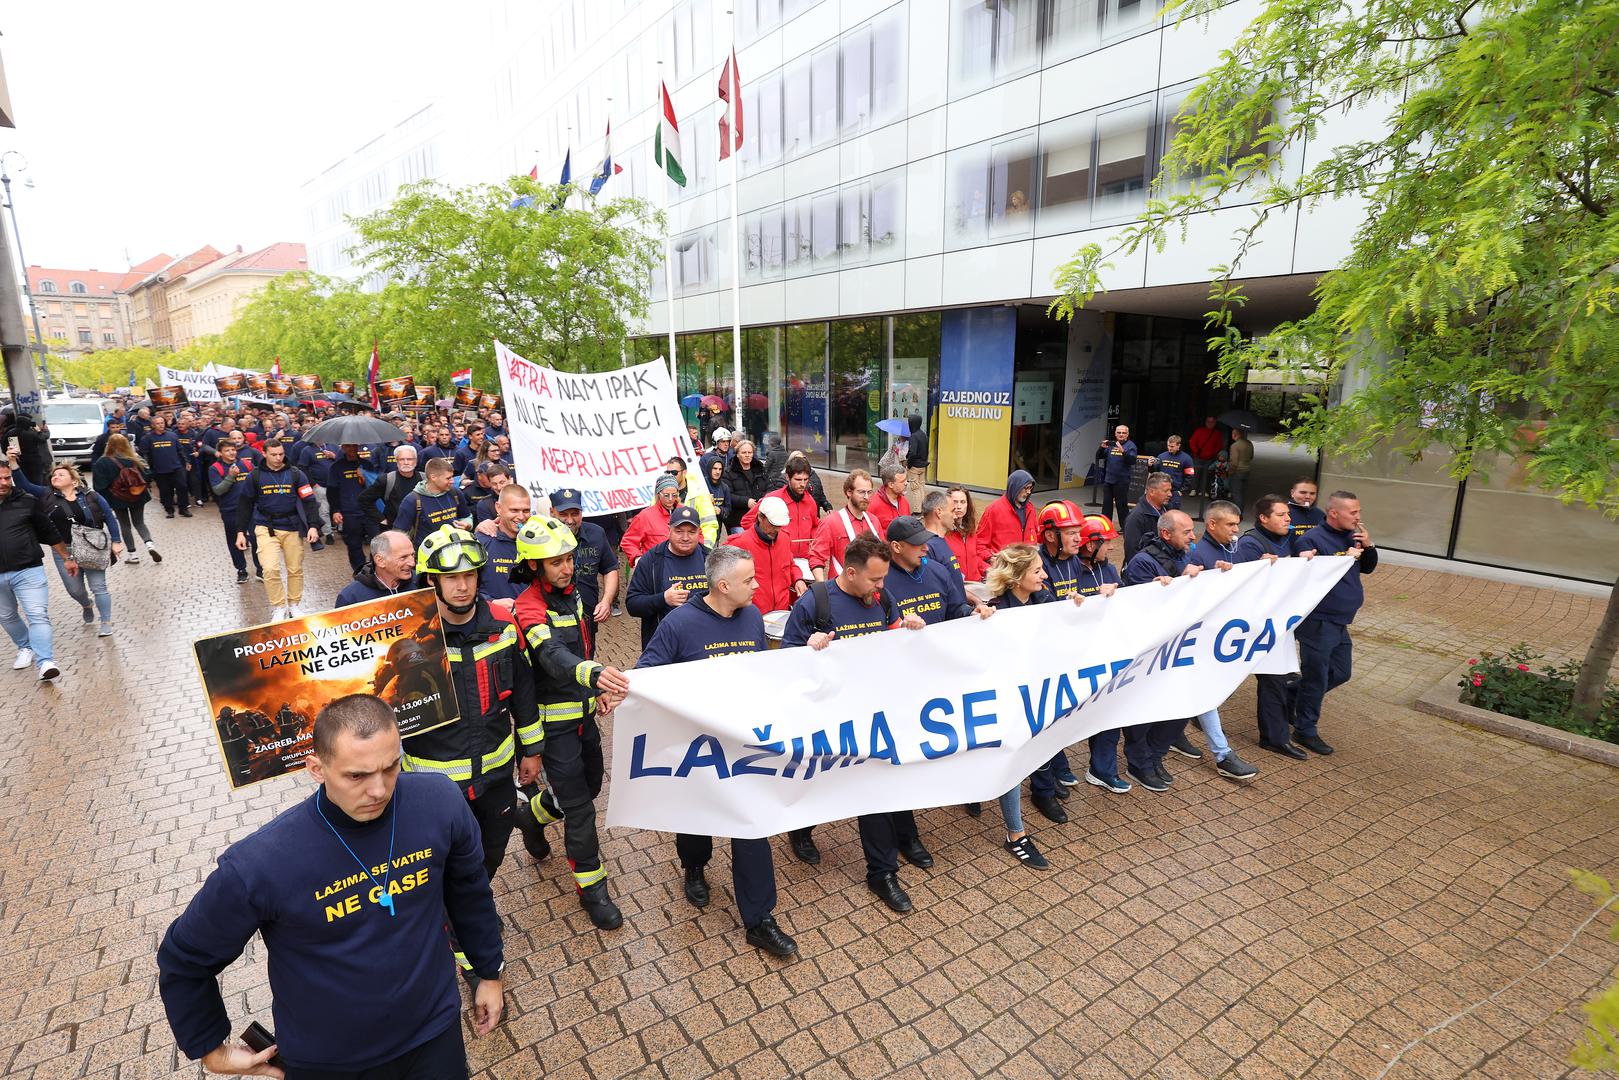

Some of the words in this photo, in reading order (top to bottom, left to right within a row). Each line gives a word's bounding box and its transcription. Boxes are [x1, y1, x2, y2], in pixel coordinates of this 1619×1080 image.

[167, 370, 216, 385] SLAVKO
[504, 351, 552, 398] VATRA
[557, 376, 602, 401] NAM
[606, 369, 658, 399] IPAK
[941, 391, 991, 404] ZAJEDNO
[994, 392, 1010, 404] UZ
[513, 393, 554, 434] NIJE
[561, 403, 661, 437] NAJVEĆI
[947, 406, 1002, 420] UKRAJINU
[686, 582, 708, 590] GASE
[902, 607, 916, 616] NE
[917, 601, 941, 613] GASE
[234, 633, 310, 658] PROSVJED
[311, 607, 413, 640] VATROGASACA
[836, 624, 858, 632] LAŽIMA
[259, 645, 323, 671] LAŽIMA
[330, 639, 350, 654] SE
[352, 624, 403, 647] VATRE
[704, 641, 728, 650] LAŽIMA
[301, 659, 325, 676] NE
[328, 646, 374, 668] GASE!
[629, 710, 901, 780] LAŽIMA
[919, 689, 1002, 760] SE
[1146, 621, 1204, 676] NE
[254, 736, 297, 754] ZAGREB,
[401, 699, 422, 711] 13,00
[423, 692, 441, 704] SATI
[409, 714, 421, 722] SATI
[315, 871, 368, 901] LAŽIMA
[371, 862, 388, 876] SE
[391, 847, 433, 869] VATRE
[325, 894, 361, 922] NE
[368, 867, 430, 904] GASE
